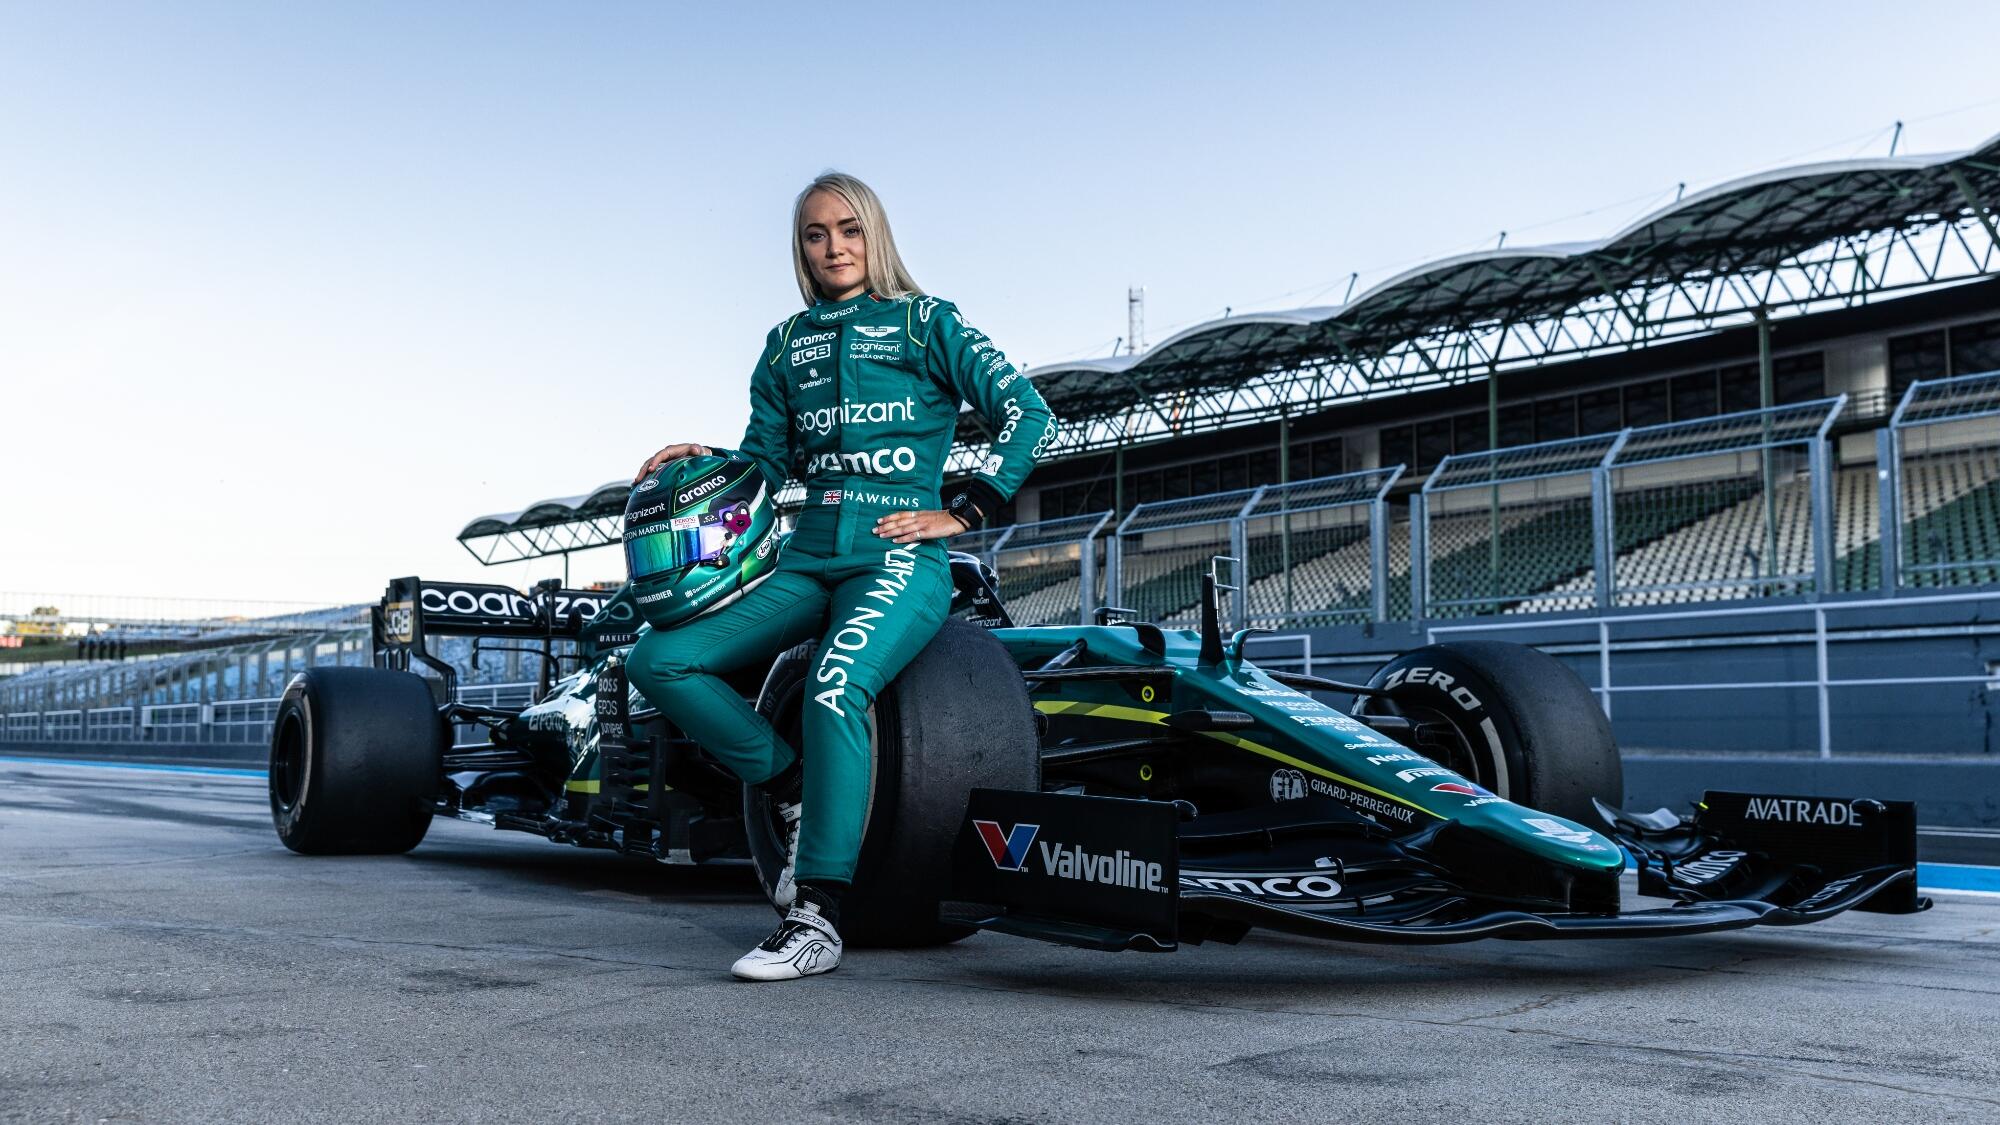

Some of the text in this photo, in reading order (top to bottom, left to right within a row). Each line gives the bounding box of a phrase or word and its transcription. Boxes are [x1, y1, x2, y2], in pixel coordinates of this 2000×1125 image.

[820, 304, 860, 321] cognizant
[791, 331, 837, 348] aramco
[850, 343, 900, 353] cognizant
[792, 345, 829, 365] JCB
[795, 396, 915, 436] cognizant
[678, 474, 727, 504] aramco
[844, 490, 920, 508] HAWKINS
[638, 522, 670, 537] MARTIN
[814, 606, 885, 718] ASTON
[598, 677, 618, 694] BOSS
[598, 699, 618, 716] EPOS
[1310, 778, 1416, 825] GIRARD-PERREGAUX
[1744, 797, 1864, 827] AVATRADE
[1039, 840, 1162, 893] Valvoline
